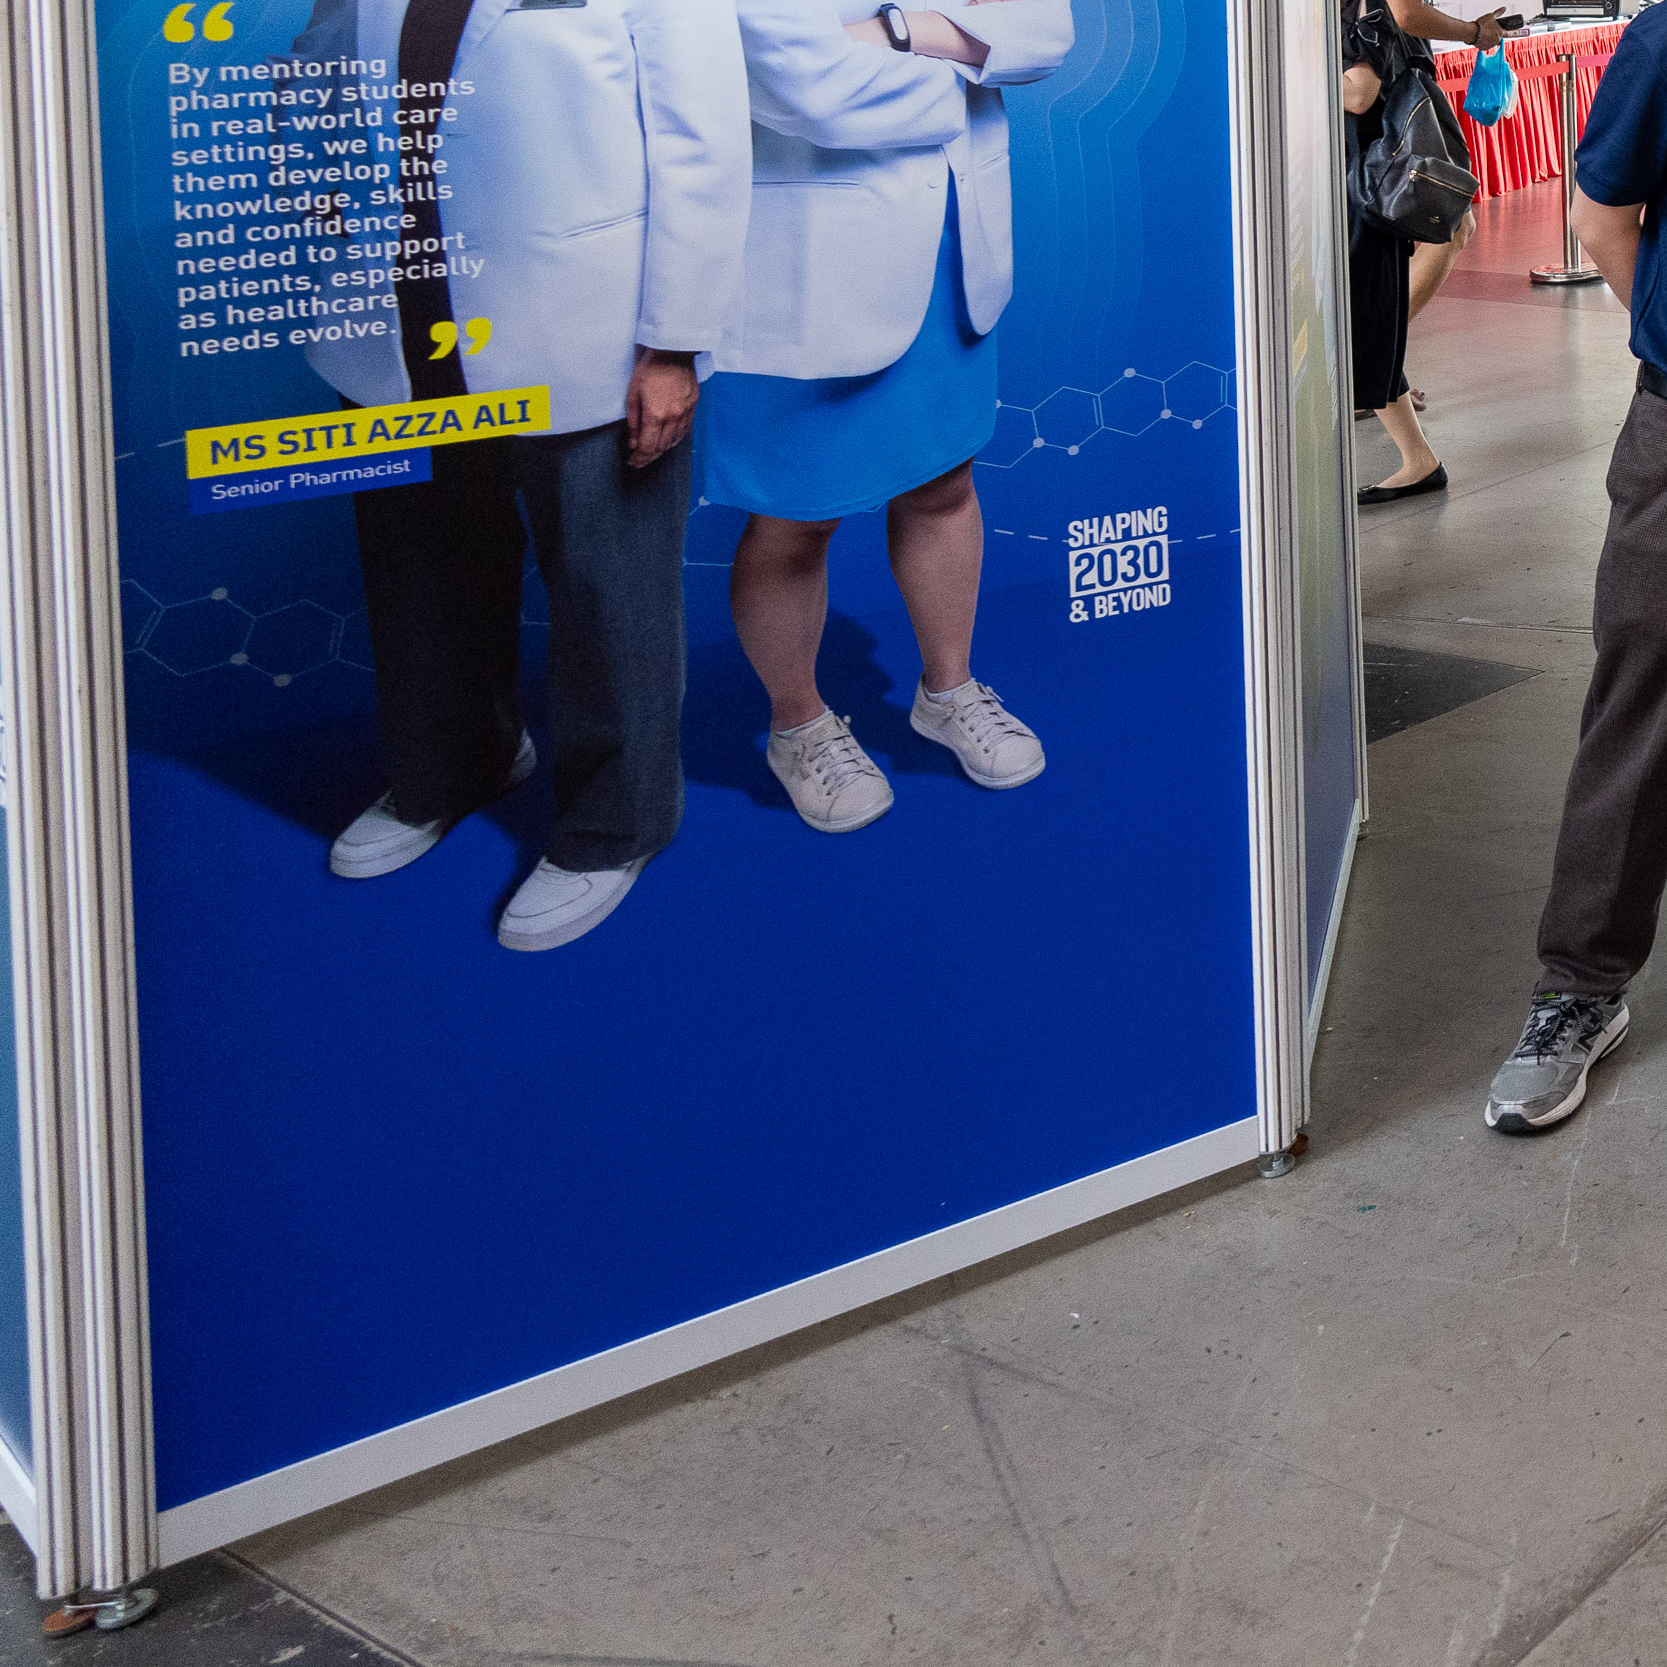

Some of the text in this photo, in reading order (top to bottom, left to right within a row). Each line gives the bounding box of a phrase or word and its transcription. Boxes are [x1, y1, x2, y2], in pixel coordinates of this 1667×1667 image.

[169, 56, 386, 88] By mentoring
[169, 75, 476, 116] pharmacy students
[210, 399, 531, 465] MS SITI AZZA ALI
[211, 458, 412, 500] Senior Pharmacist
[1068, 506, 1168, 548] SHAPING
[1074, 540, 1164, 593] 2030
[1069, 584, 1171, 623] & BEYOND
